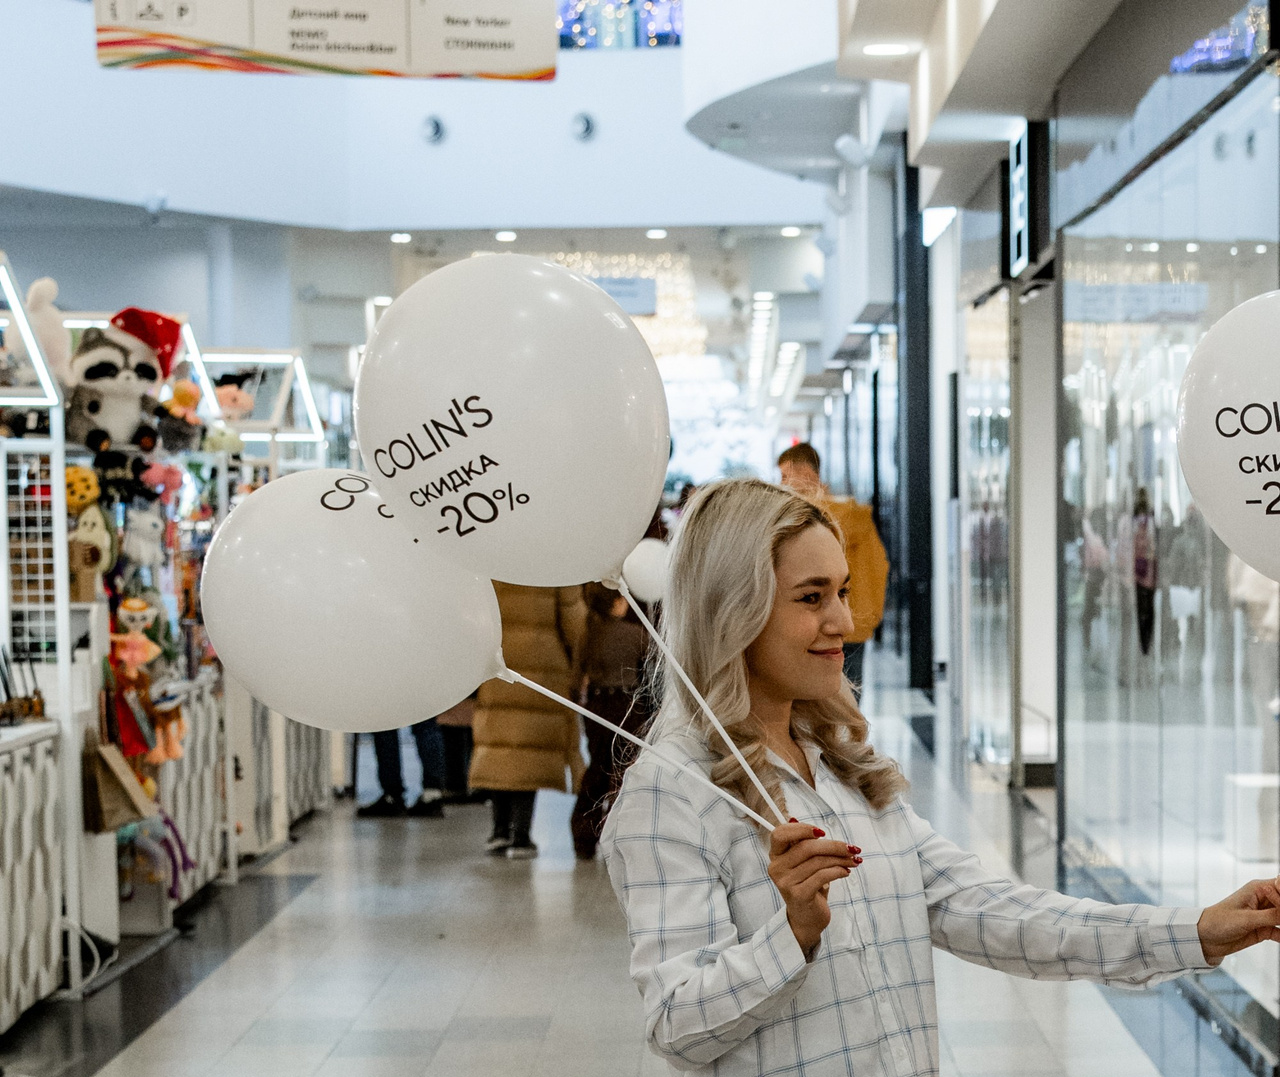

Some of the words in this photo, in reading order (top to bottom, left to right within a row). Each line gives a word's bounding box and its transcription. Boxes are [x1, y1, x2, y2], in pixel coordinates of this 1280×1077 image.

[373, 395, 493, 479] COLIN'S
[409, 454, 500, 508] СКИДКА
[436, 481, 531, 538] -20%
